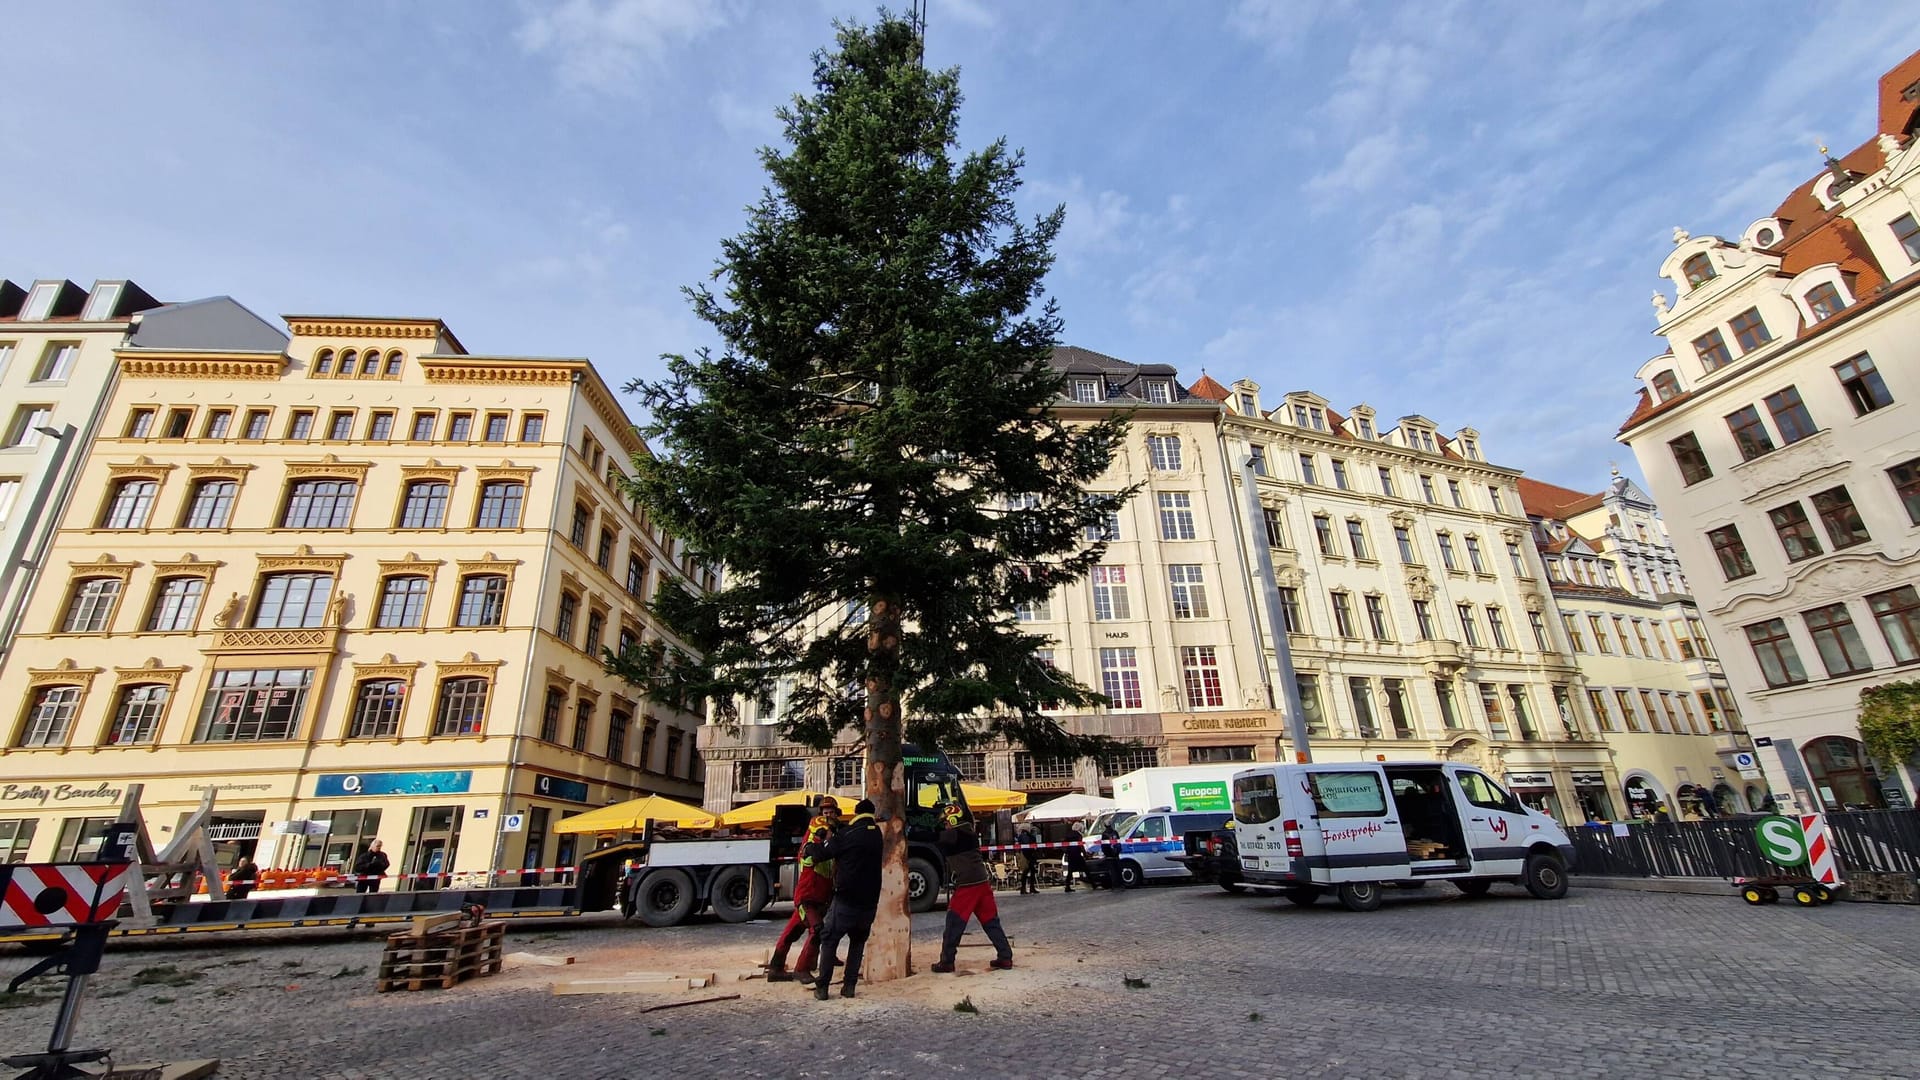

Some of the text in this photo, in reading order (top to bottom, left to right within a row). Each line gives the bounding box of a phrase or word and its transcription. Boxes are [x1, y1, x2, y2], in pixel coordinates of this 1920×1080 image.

[1105, 631, 1129, 639] HAUS
[1183, 717, 1267, 730] CENTRAL KABARETT
[1, 781, 122, 806] Betty Barclay
[1180, 787, 1222, 798] Europcar
[1321, 821, 1382, 846] Forstprofis
[1762, 820, 1802, 862] S
